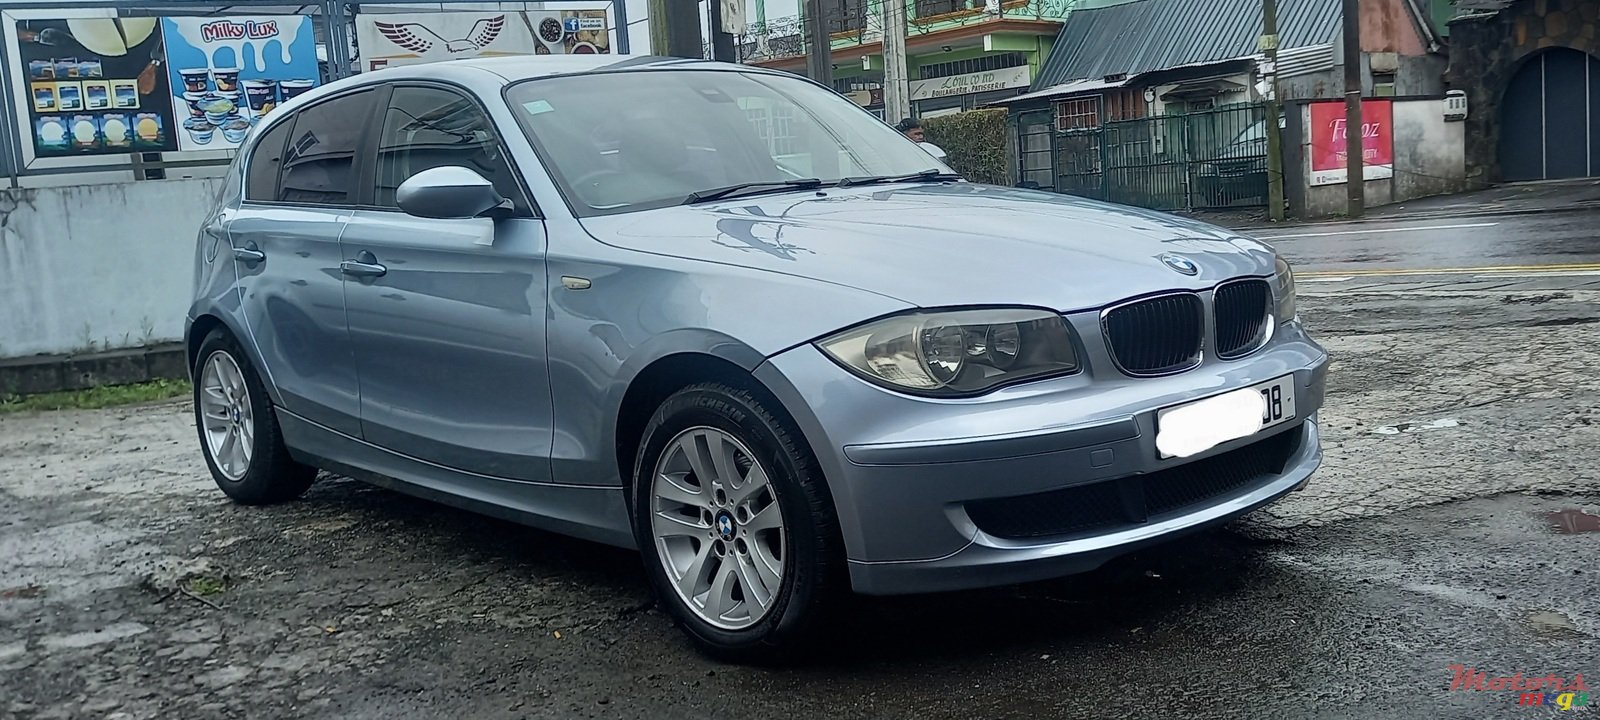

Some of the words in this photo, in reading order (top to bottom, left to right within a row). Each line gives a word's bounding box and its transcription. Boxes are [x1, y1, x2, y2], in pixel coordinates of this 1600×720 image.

[203, 22, 244, 41] Milky
[247, 21, 277, 38] Lux
[932, 87, 967, 97] BOULANGERIE
[971, 82, 1006, 92] PATISSERIE
